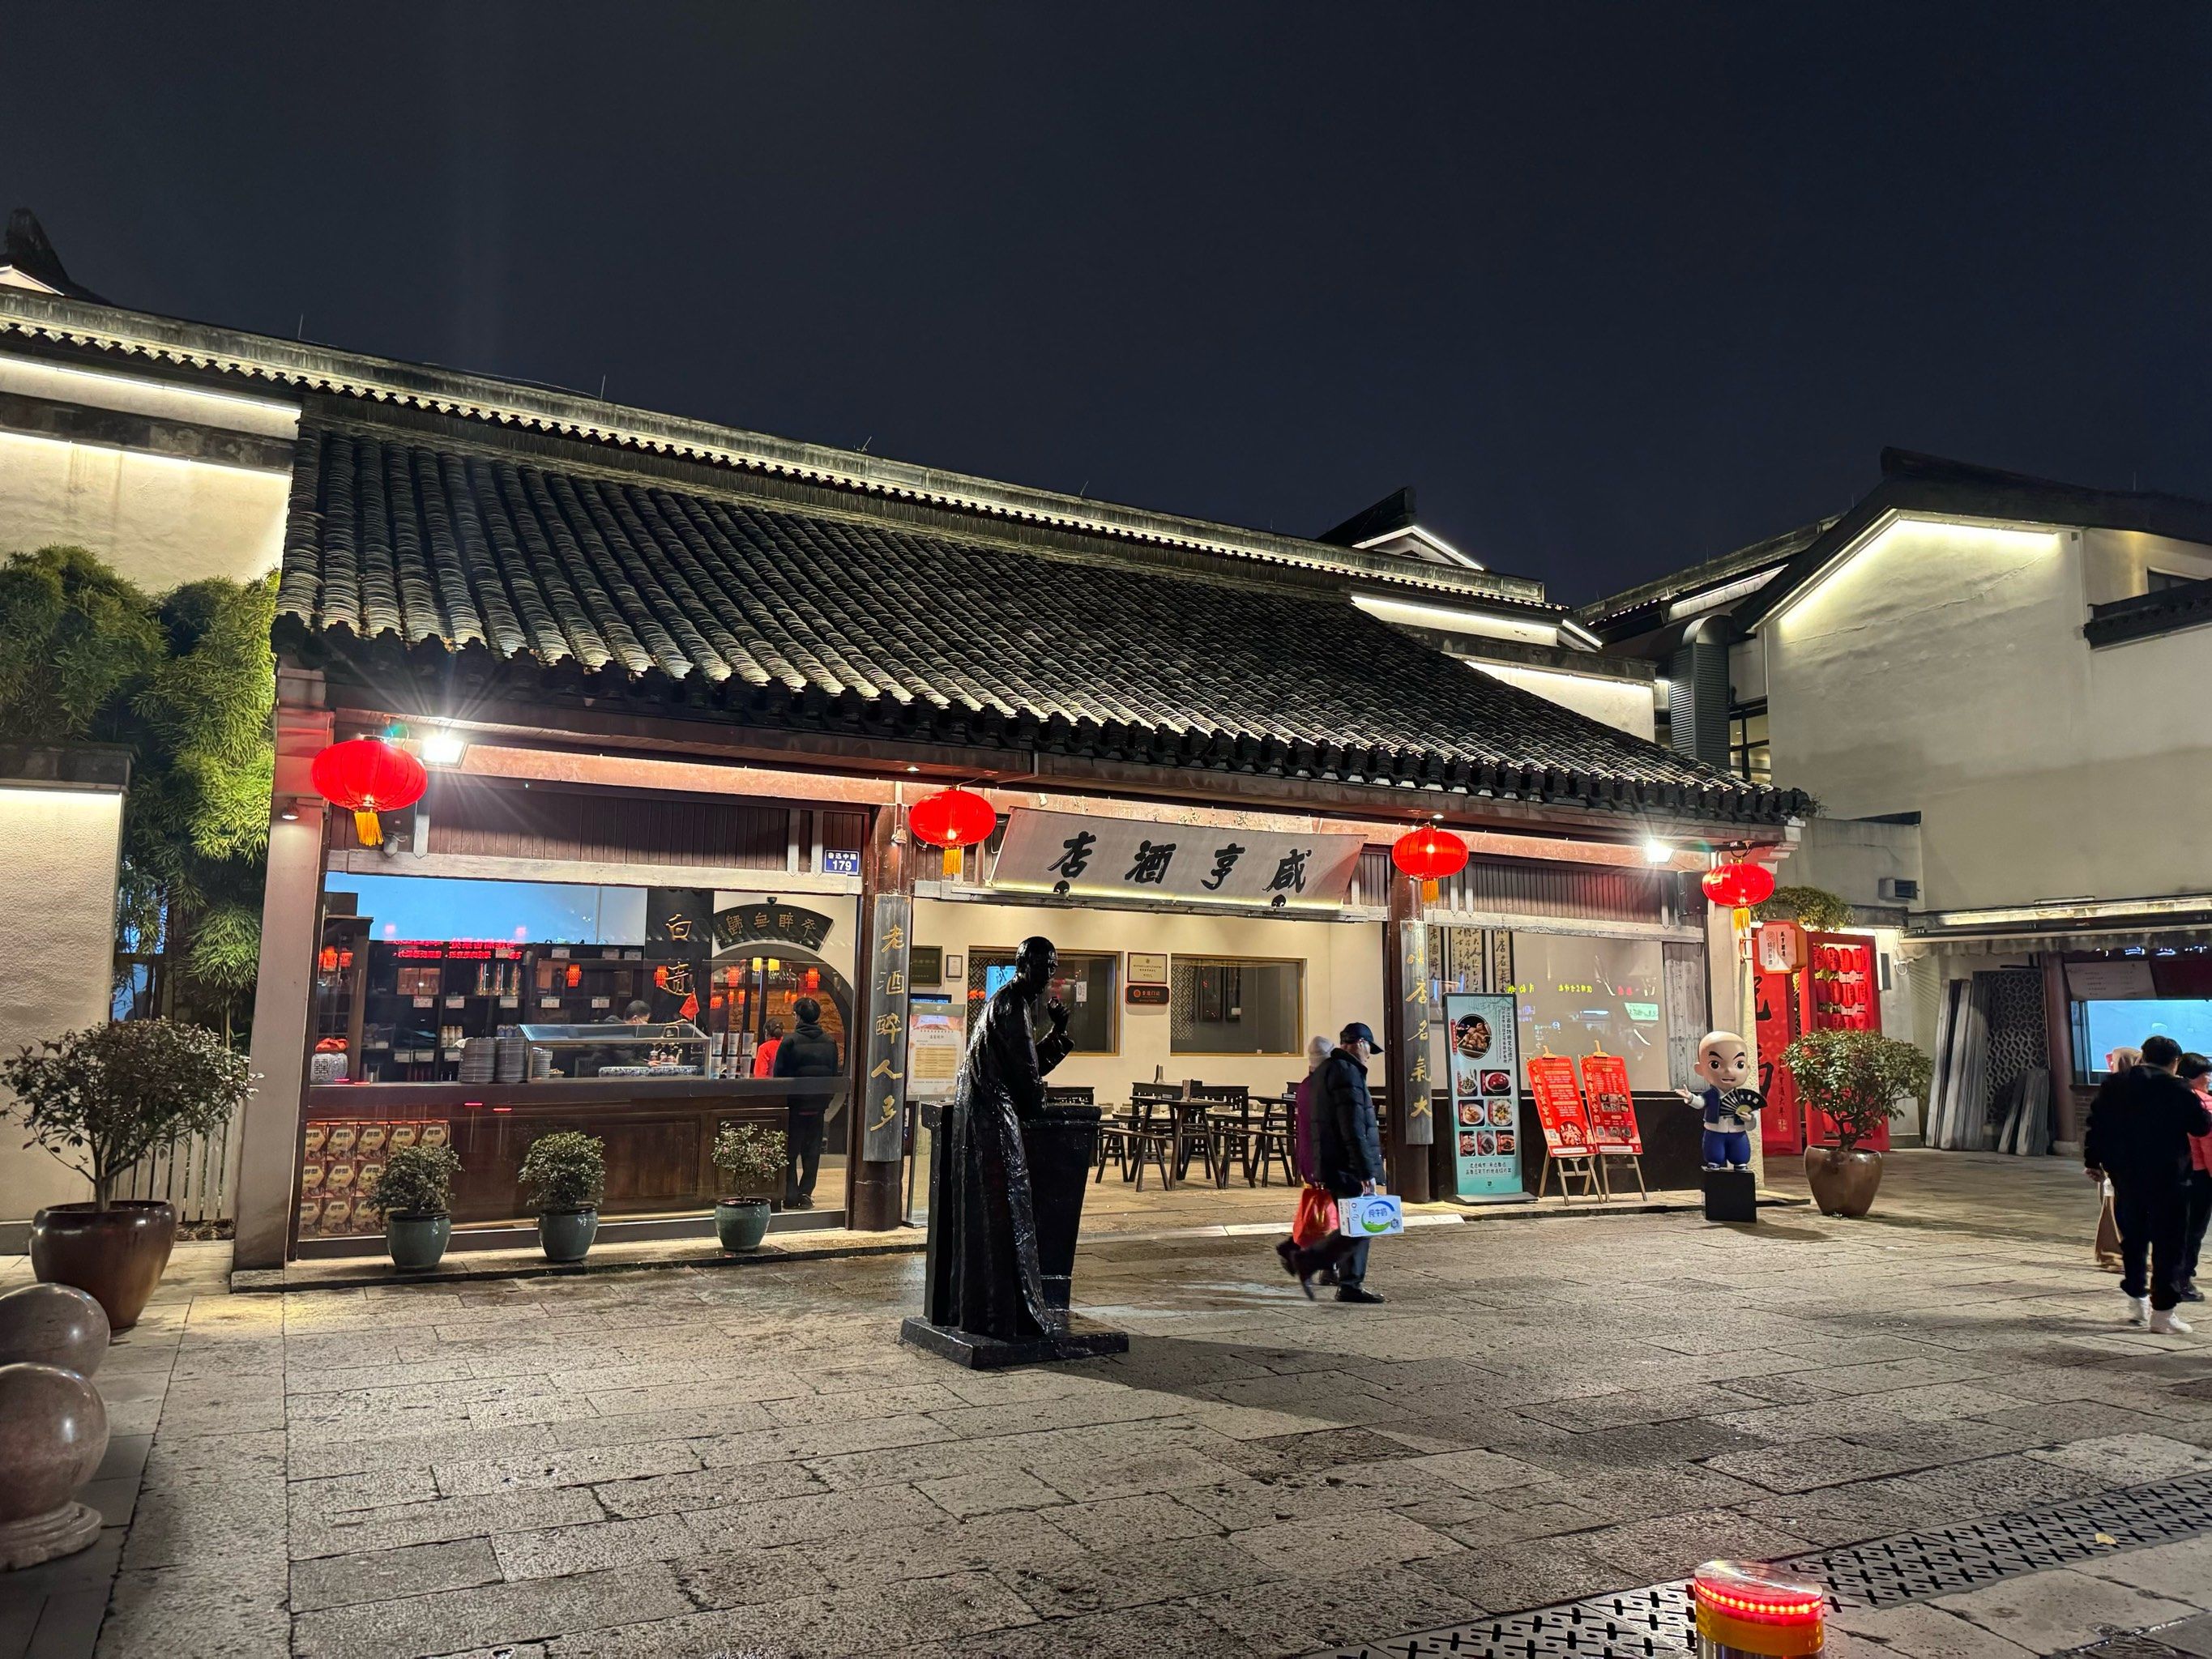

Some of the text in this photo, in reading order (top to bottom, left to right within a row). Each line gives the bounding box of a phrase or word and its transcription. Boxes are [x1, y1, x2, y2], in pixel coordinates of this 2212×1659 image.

[833, 859, 852, 871] 179
[1048, 831, 1311, 893] 咸亨酒店
[870, 924, 904, 1132] 老酒醉人多
[1406, 948, 1432, 1118] 小店名氣大
